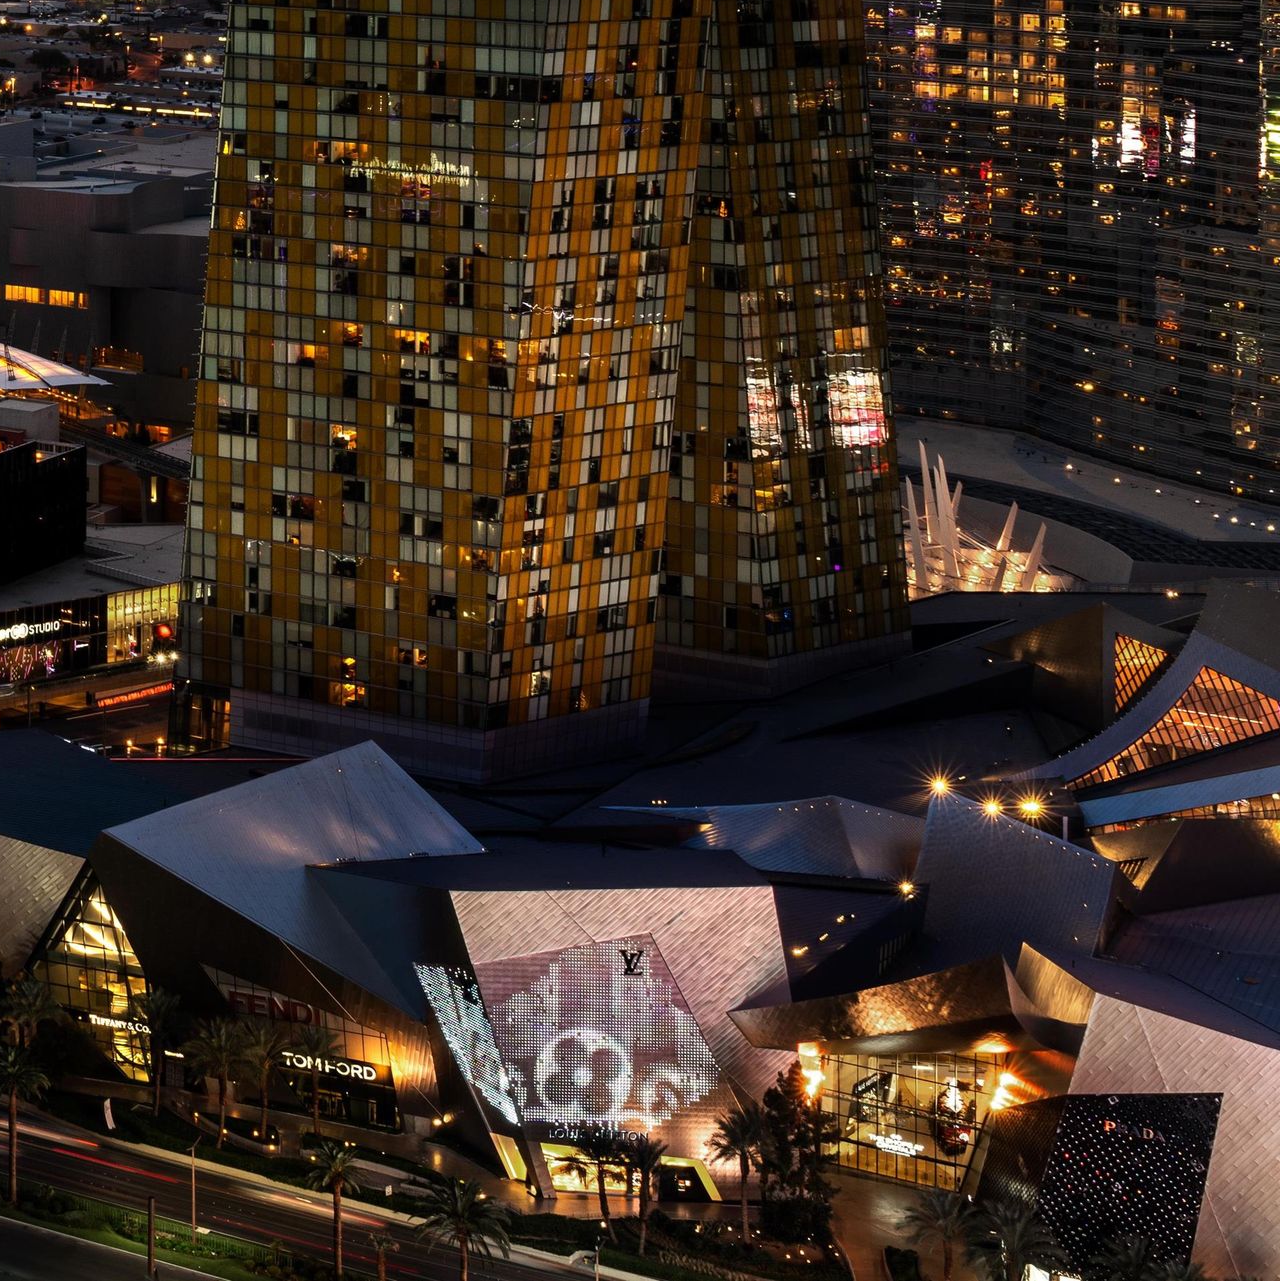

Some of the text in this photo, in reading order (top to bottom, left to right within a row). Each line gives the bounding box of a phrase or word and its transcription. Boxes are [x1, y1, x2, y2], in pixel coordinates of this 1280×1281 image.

[29, 620, 60, 636] STUDIO
[619, 949, 645, 976] LV
[229, 990, 321, 1028] FENDI
[89, 1013, 127, 1029] TIFFANY
[127, 1022, 136, 1031] &
[281, 1051, 377, 1081] TOM FORD
[1103, 1119, 1166, 1142] PRADA
